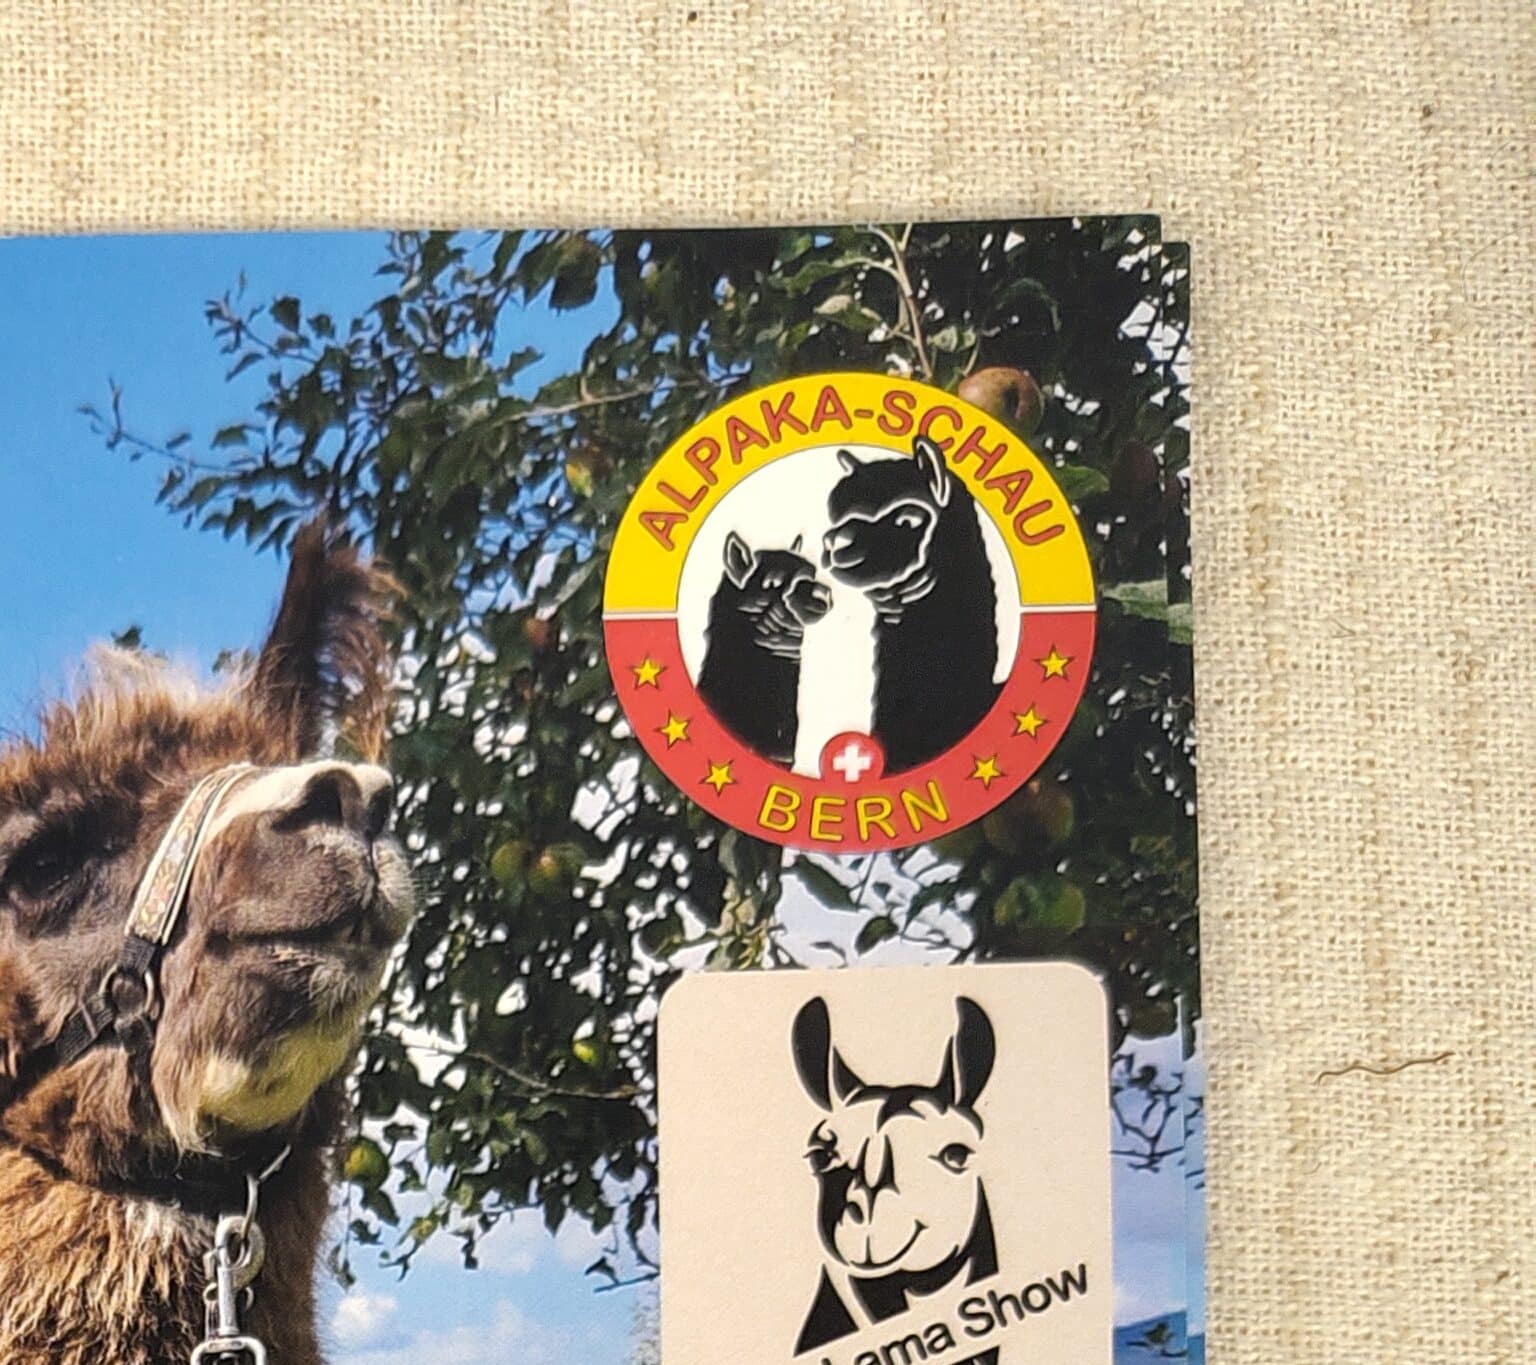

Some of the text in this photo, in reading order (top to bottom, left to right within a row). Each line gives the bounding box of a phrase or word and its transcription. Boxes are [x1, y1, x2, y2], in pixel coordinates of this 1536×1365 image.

[639, 385, 1065, 551] ALPAKA-SCHAU
[758, 780, 949, 842] BERN
[958, 1263, 1087, 1338] Show
